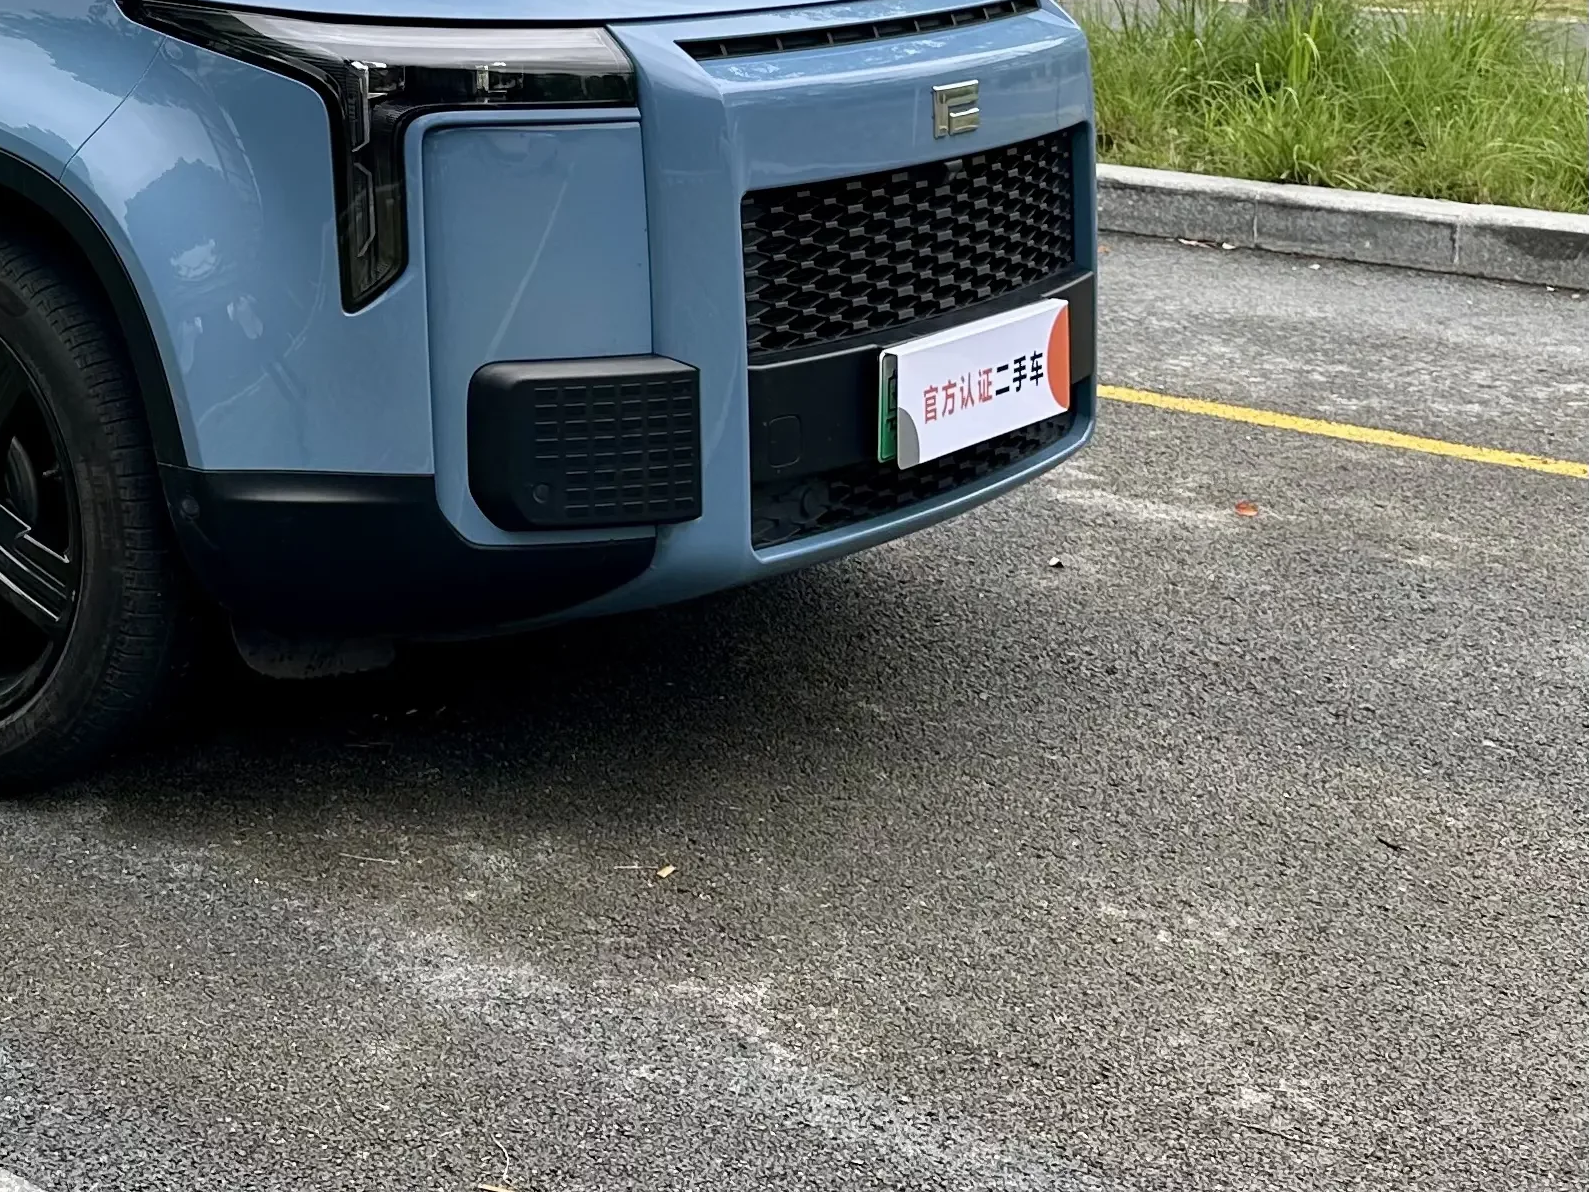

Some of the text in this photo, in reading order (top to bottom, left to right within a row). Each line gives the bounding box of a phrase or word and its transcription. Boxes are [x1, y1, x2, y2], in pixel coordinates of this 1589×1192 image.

[923, 350, 1044, 425] 官方认证二手车
